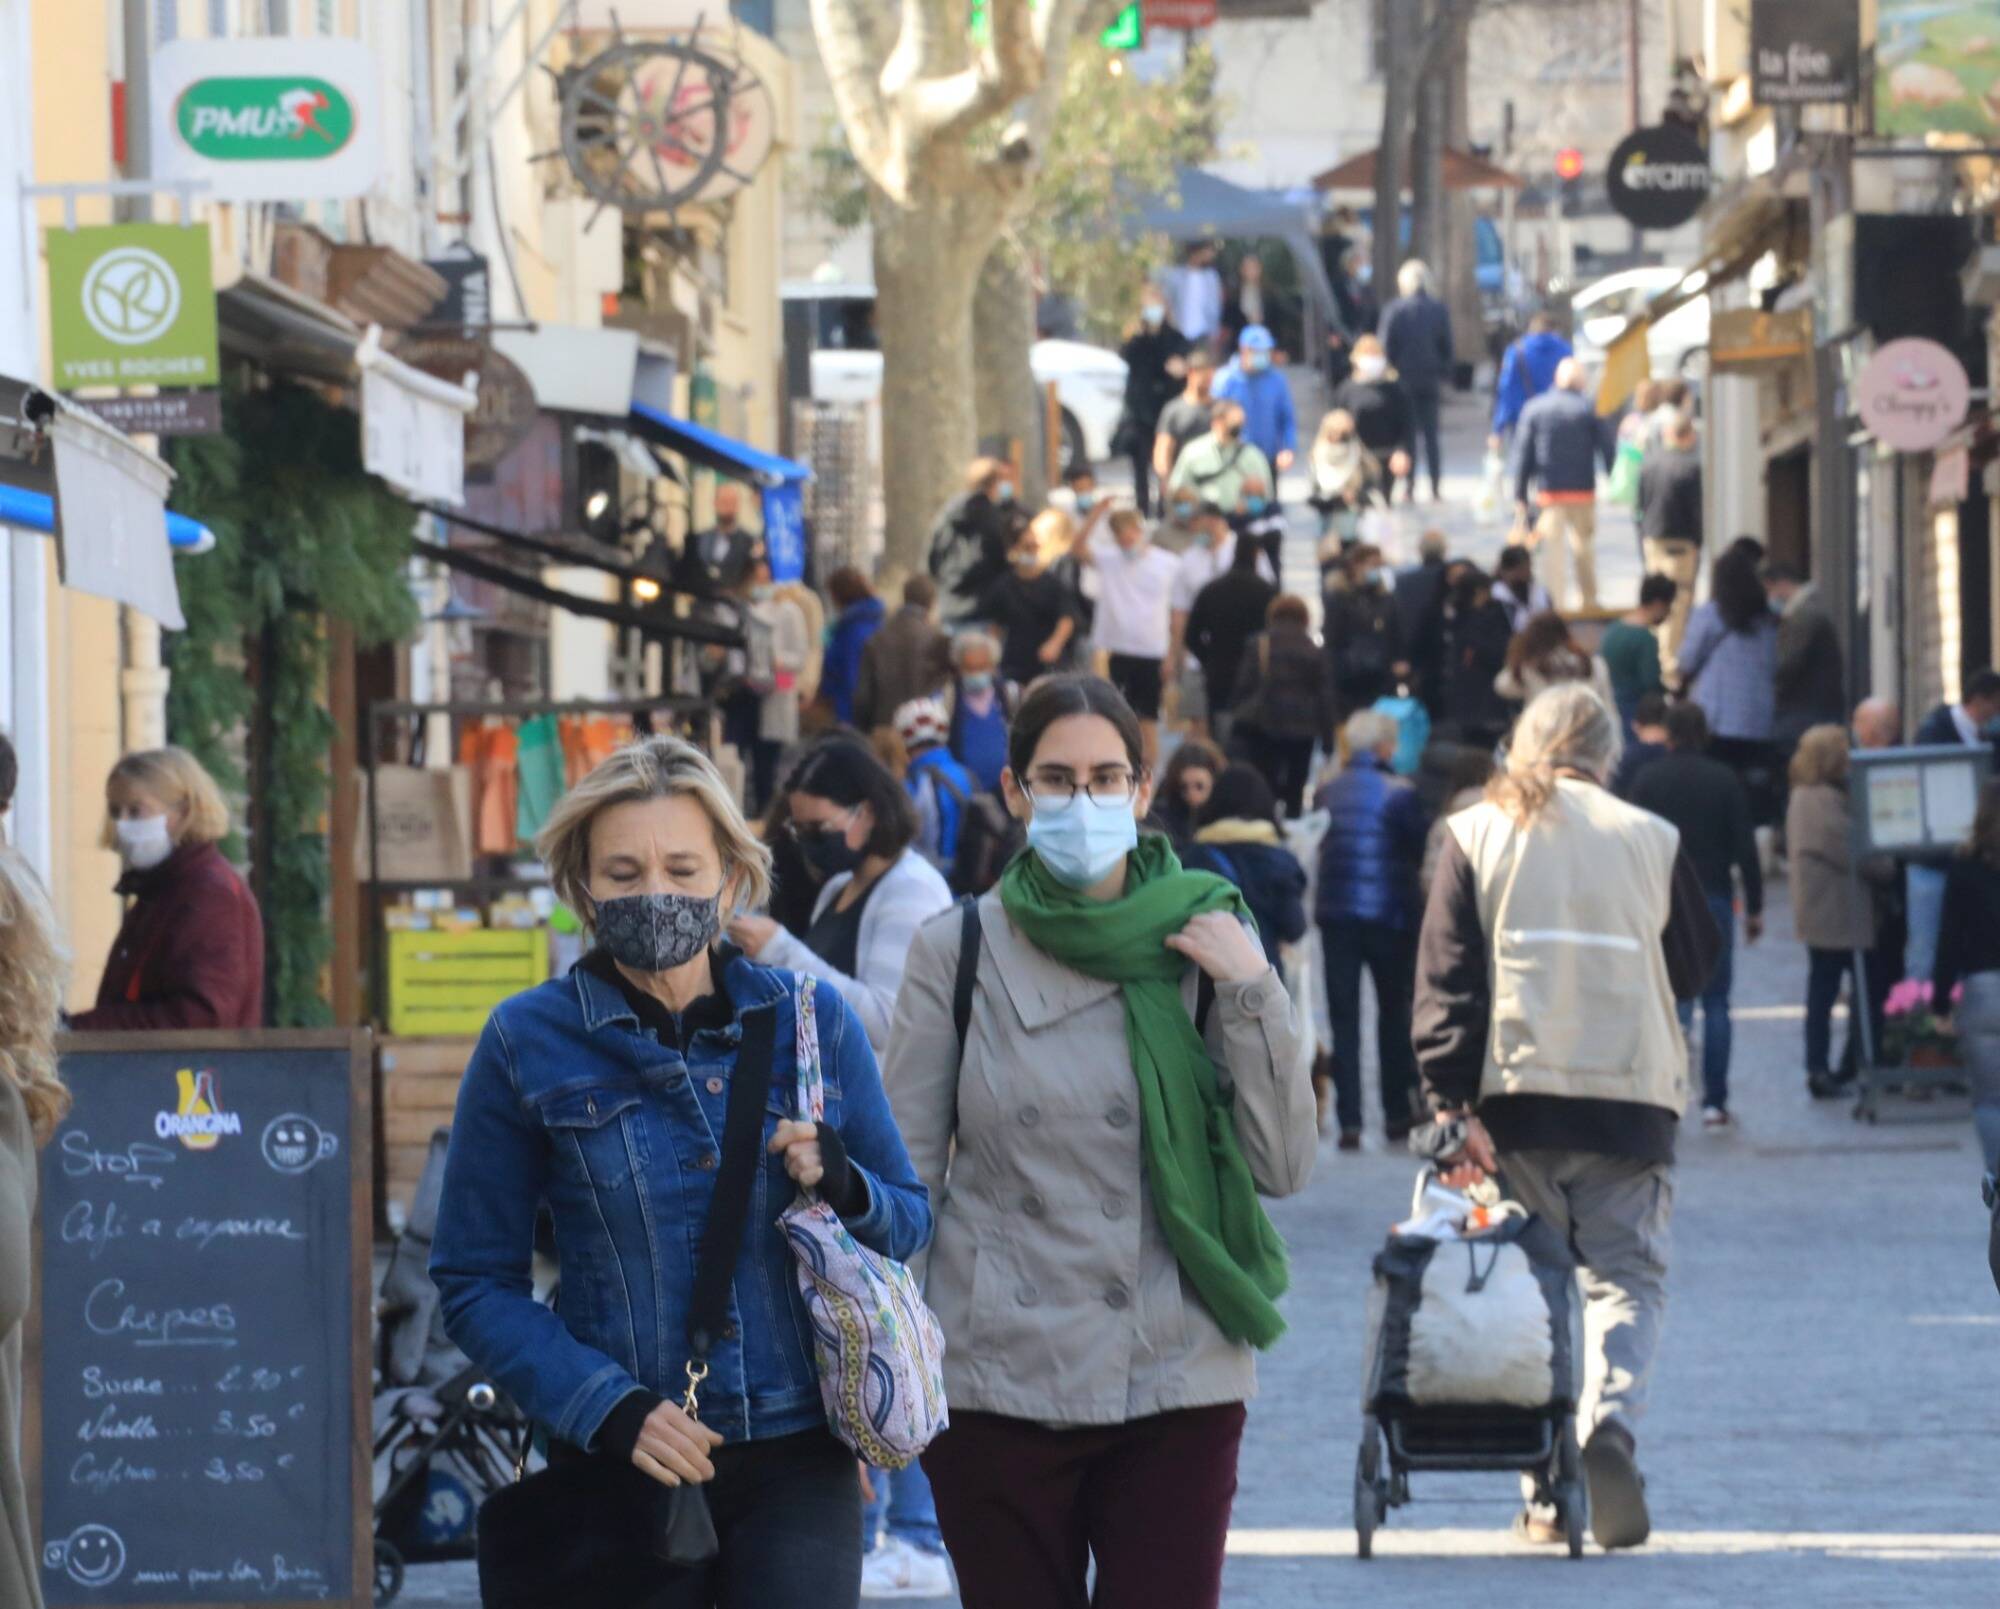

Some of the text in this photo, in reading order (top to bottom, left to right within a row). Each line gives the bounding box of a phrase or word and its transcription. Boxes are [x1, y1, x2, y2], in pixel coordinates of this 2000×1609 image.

[191, 105, 275, 138] PMU
[63, 356, 206, 379] YVES ROCHER
[155, 1111, 242, 1138] ORANGINA
